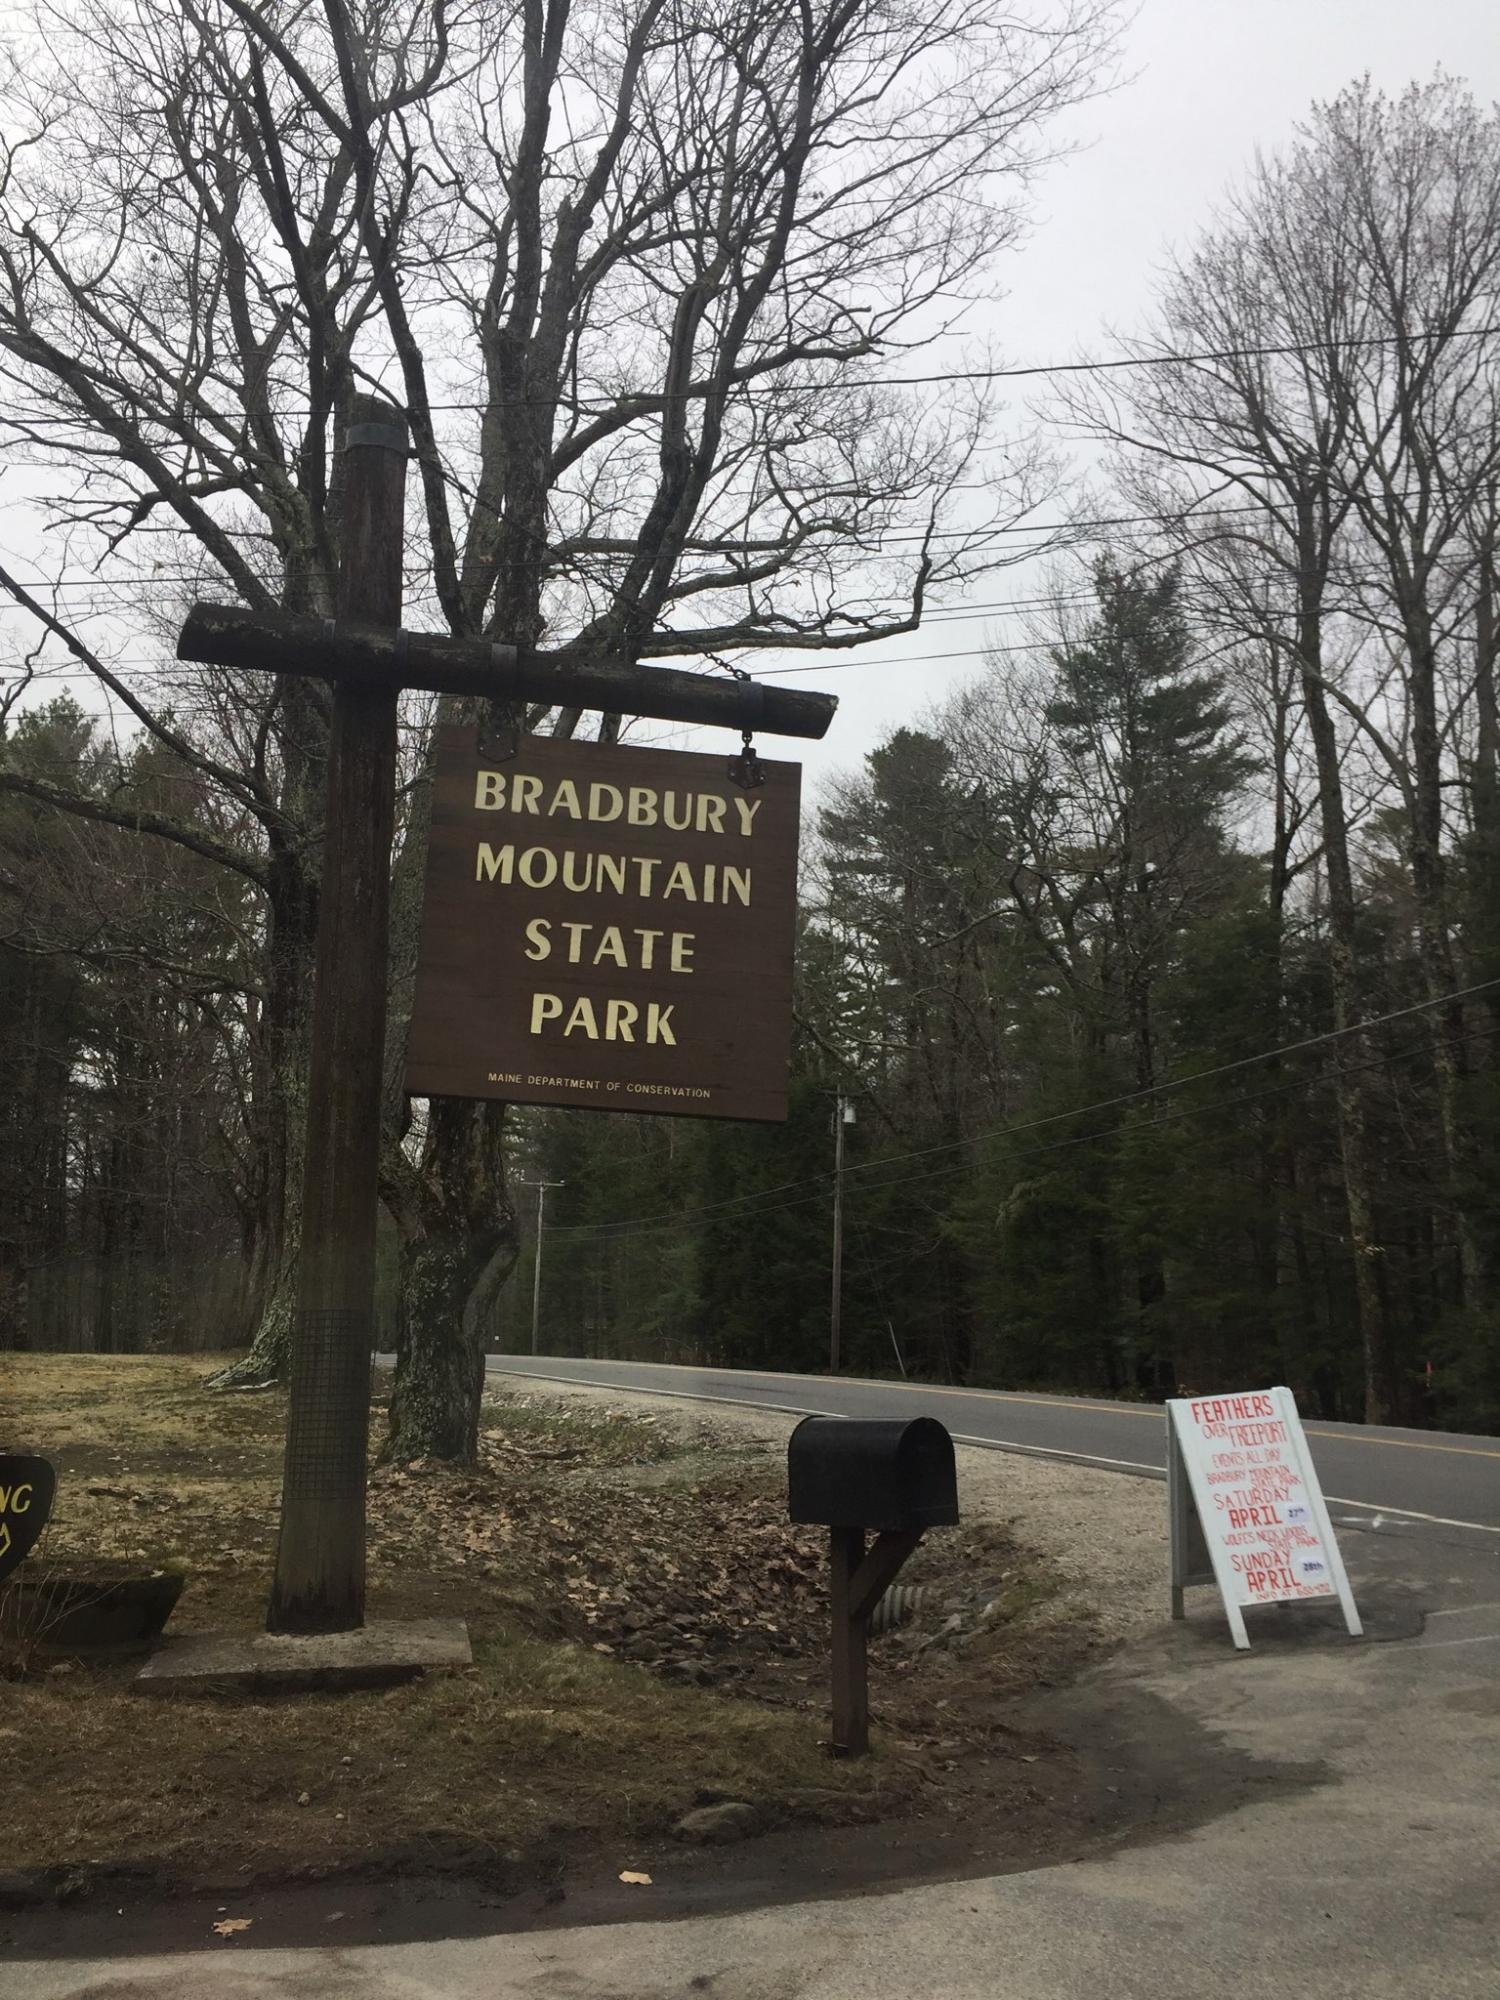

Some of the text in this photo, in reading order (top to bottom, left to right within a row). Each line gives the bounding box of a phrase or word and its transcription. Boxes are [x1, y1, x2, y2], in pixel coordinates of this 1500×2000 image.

[474, 770, 762, 836] BRADBURY
[475, 842, 751, 907] MOUNTAIN
[524, 918, 695, 973] STATE
[530, 993, 677, 1046] PARK
[488, 1072, 711, 1099] MAINE DEPARTMENT OF CONSERVATION
[1191, 1395, 1274, 1425] FEATHERS
[1202, 1421, 1288, 1447] OVER FREEPORT
[1213, 1487, 1291, 1510] SATURDAY
[1228, 1505, 1283, 1529] APRIL
[1231, 1549, 1291, 1573] SUNDAY
[1246, 1567, 1302, 1593] APRIL
